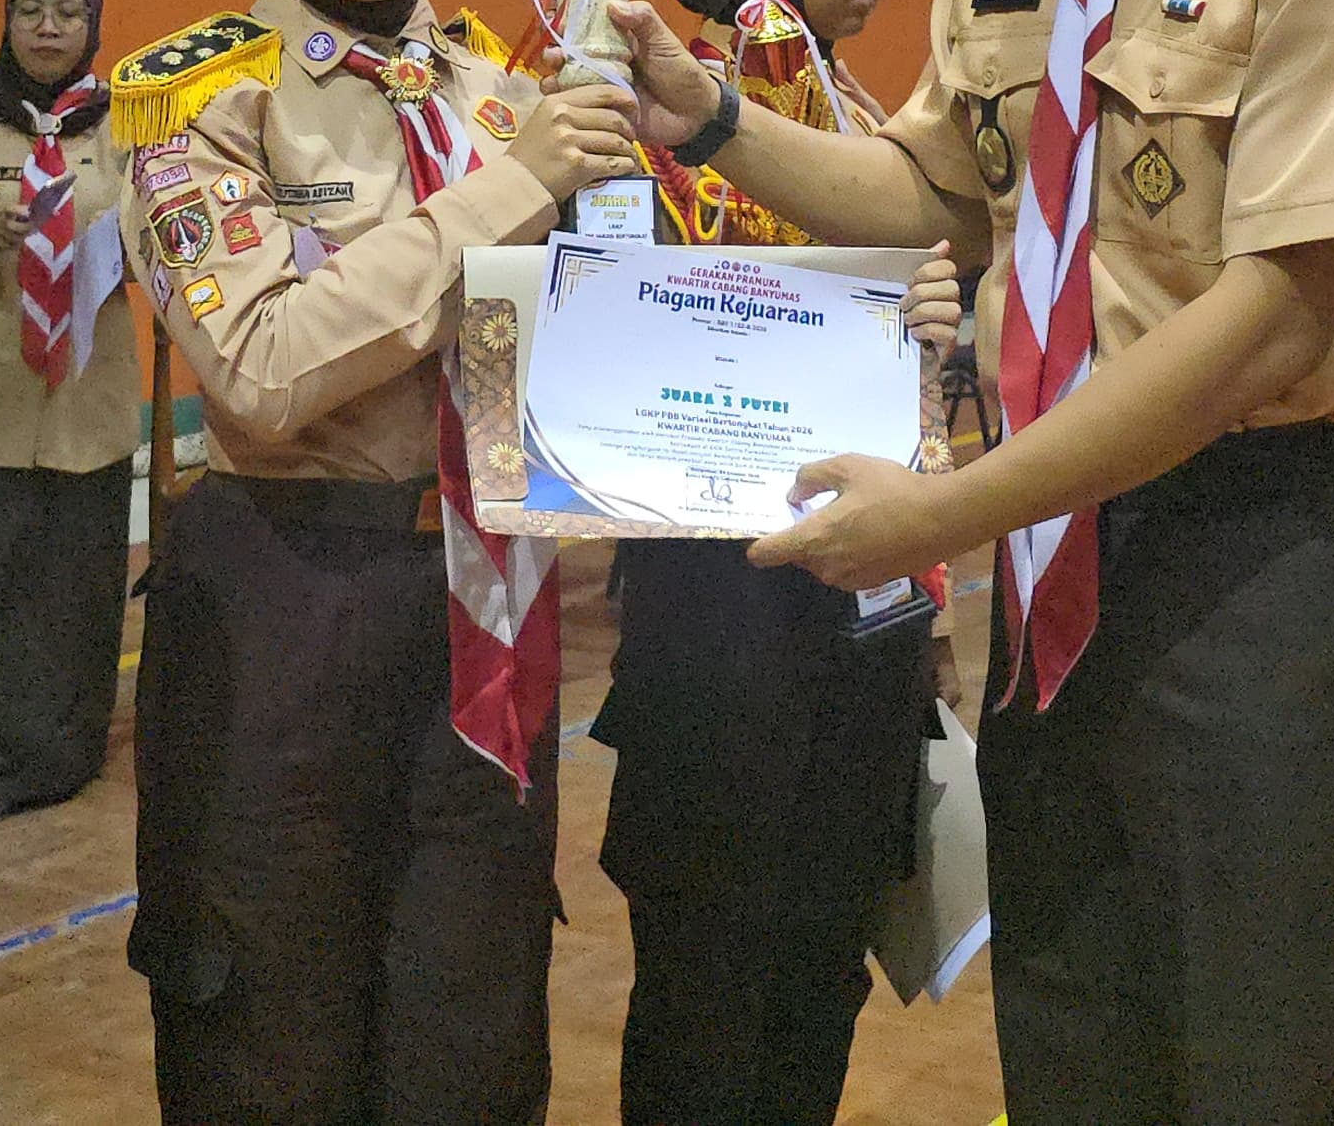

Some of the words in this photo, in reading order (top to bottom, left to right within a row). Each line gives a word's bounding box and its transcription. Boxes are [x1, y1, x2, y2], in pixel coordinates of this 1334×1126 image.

[667, 275, 710, 290] KWARTIR
[712, 282, 748, 295] CABANG
[750, 287, 800, 302] BANYUMAS
[690, 266, 734, 282] GERAKAN
[736, 274, 781, 289] PRAMUKA
[638, 281, 715, 312] Piagam
[720, 293, 824, 327] Kejuaraan
[660, 387, 714, 405] JUARA
[740, 397, 789, 414] PUTRI
[635, 408, 660, 419] LGKP
[681, 412, 711, 424] Variasi
[713, 417, 762, 431] Bertongkat
[763, 422, 789, 432] Tahun
[791, 425, 814, 435] 2026
[657, 422, 700, 434] KWARTIR
[701, 426, 739, 439] CABANG
[741, 430, 792, 443] BANYUMAS
